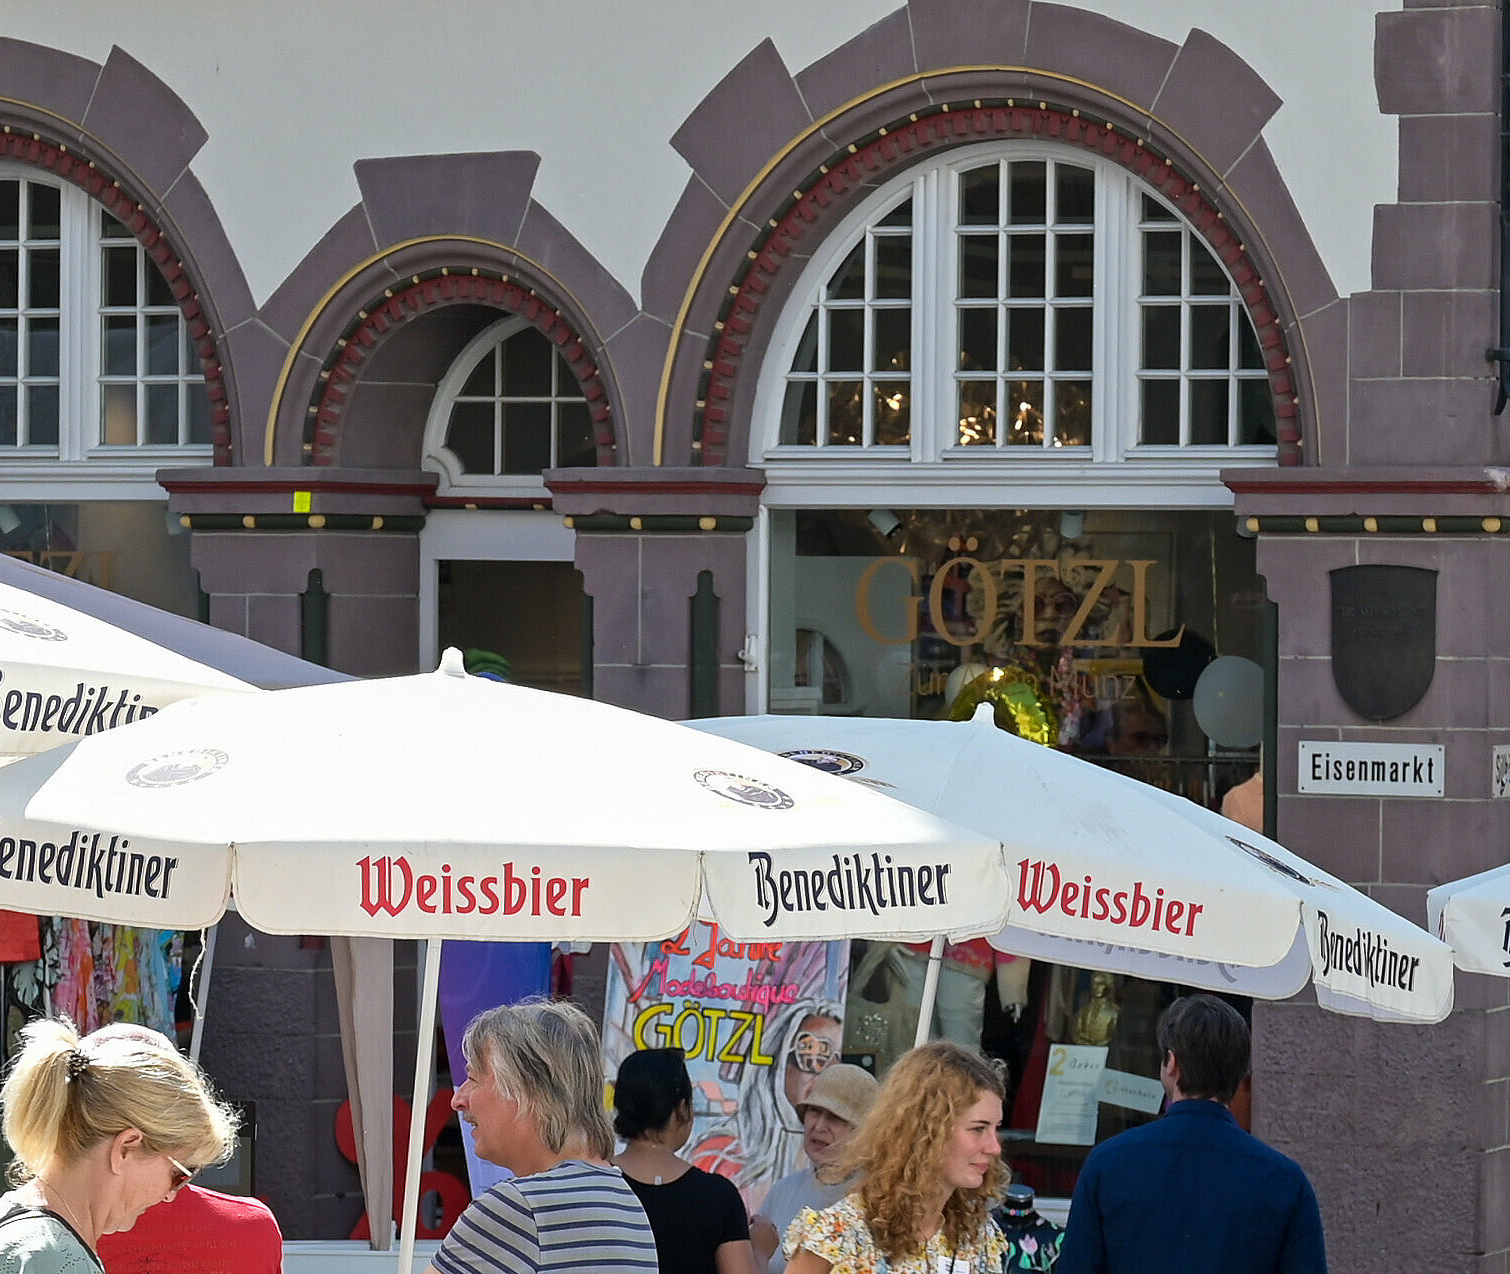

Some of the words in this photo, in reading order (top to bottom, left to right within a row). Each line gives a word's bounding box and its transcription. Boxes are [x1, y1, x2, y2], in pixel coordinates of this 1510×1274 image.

[855, 536, 1186, 649] GÖTZL
[1311, 753, 1435, 785] Eisenmarkt
[357, 855, 590, 917] Weissbier
[748, 851, 950, 928] Benediktiner
[1016, 857, 1205, 937] Weissbier
[1316, 908, 1421, 993] Benediktiner
[633, 998, 775, 1067] GÖTZL
